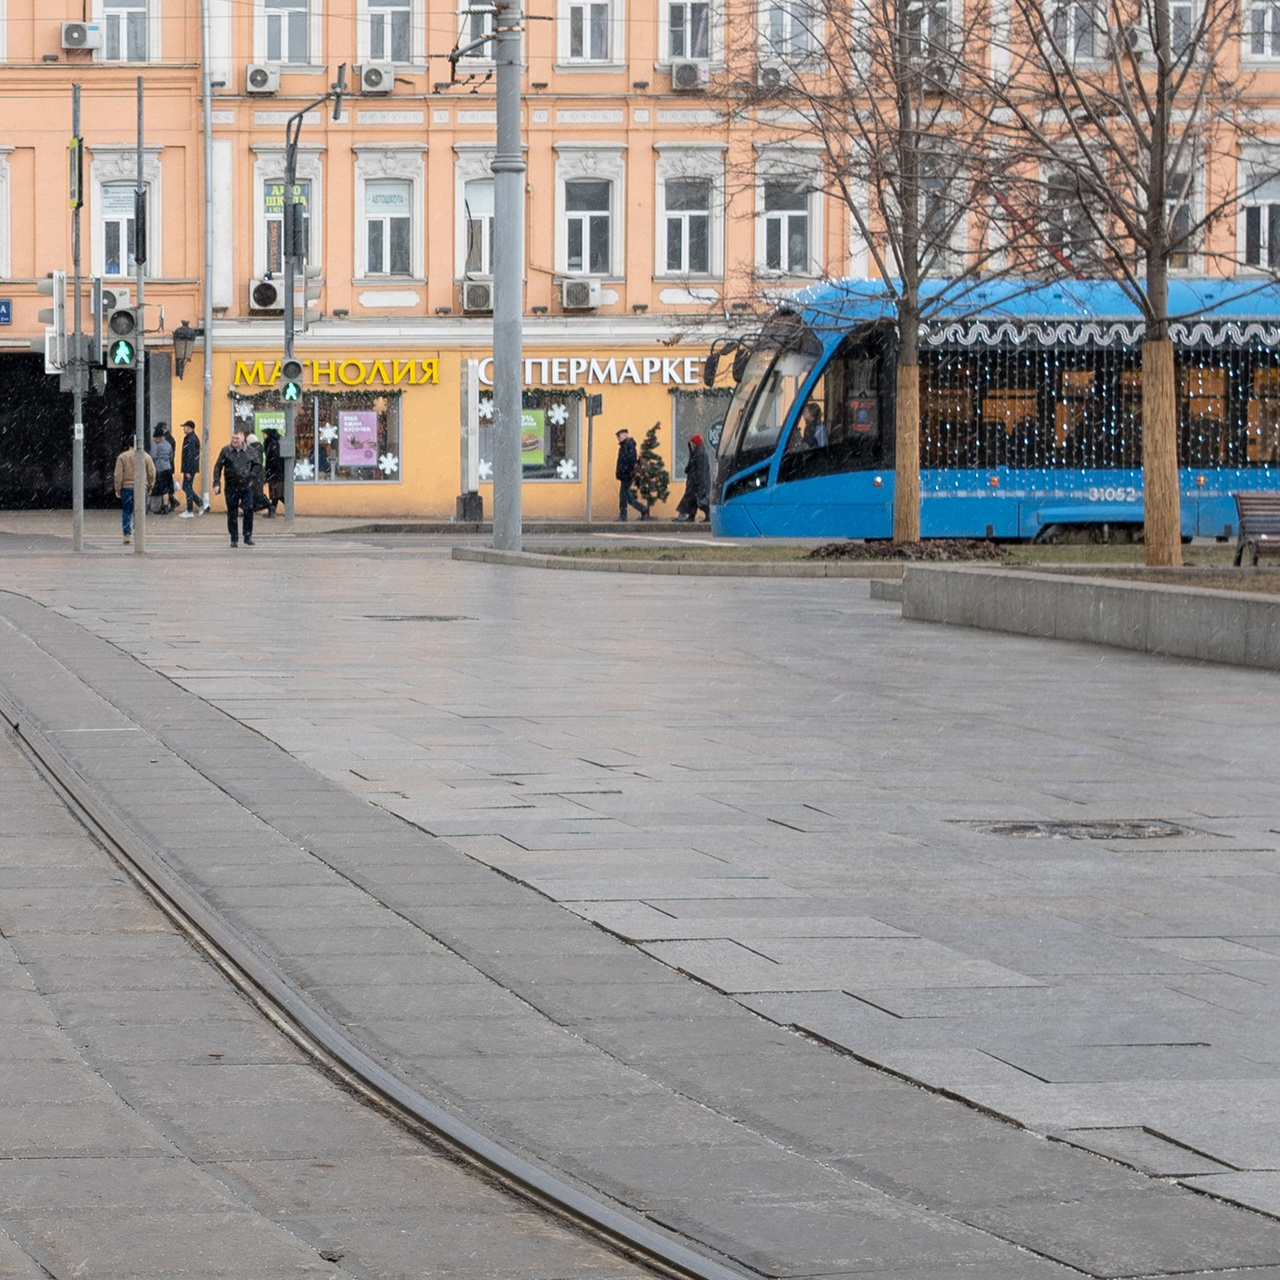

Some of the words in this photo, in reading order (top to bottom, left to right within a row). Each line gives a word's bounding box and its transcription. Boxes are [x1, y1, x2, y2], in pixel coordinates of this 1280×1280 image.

[266, 196, 307, 206] ШКЛА
[234, 358, 440, 386] МАНОЛИЯ
[477, 357, 707, 385] СПЕРМАРКЕ
[1089, 487, 1136, 501] 31052
